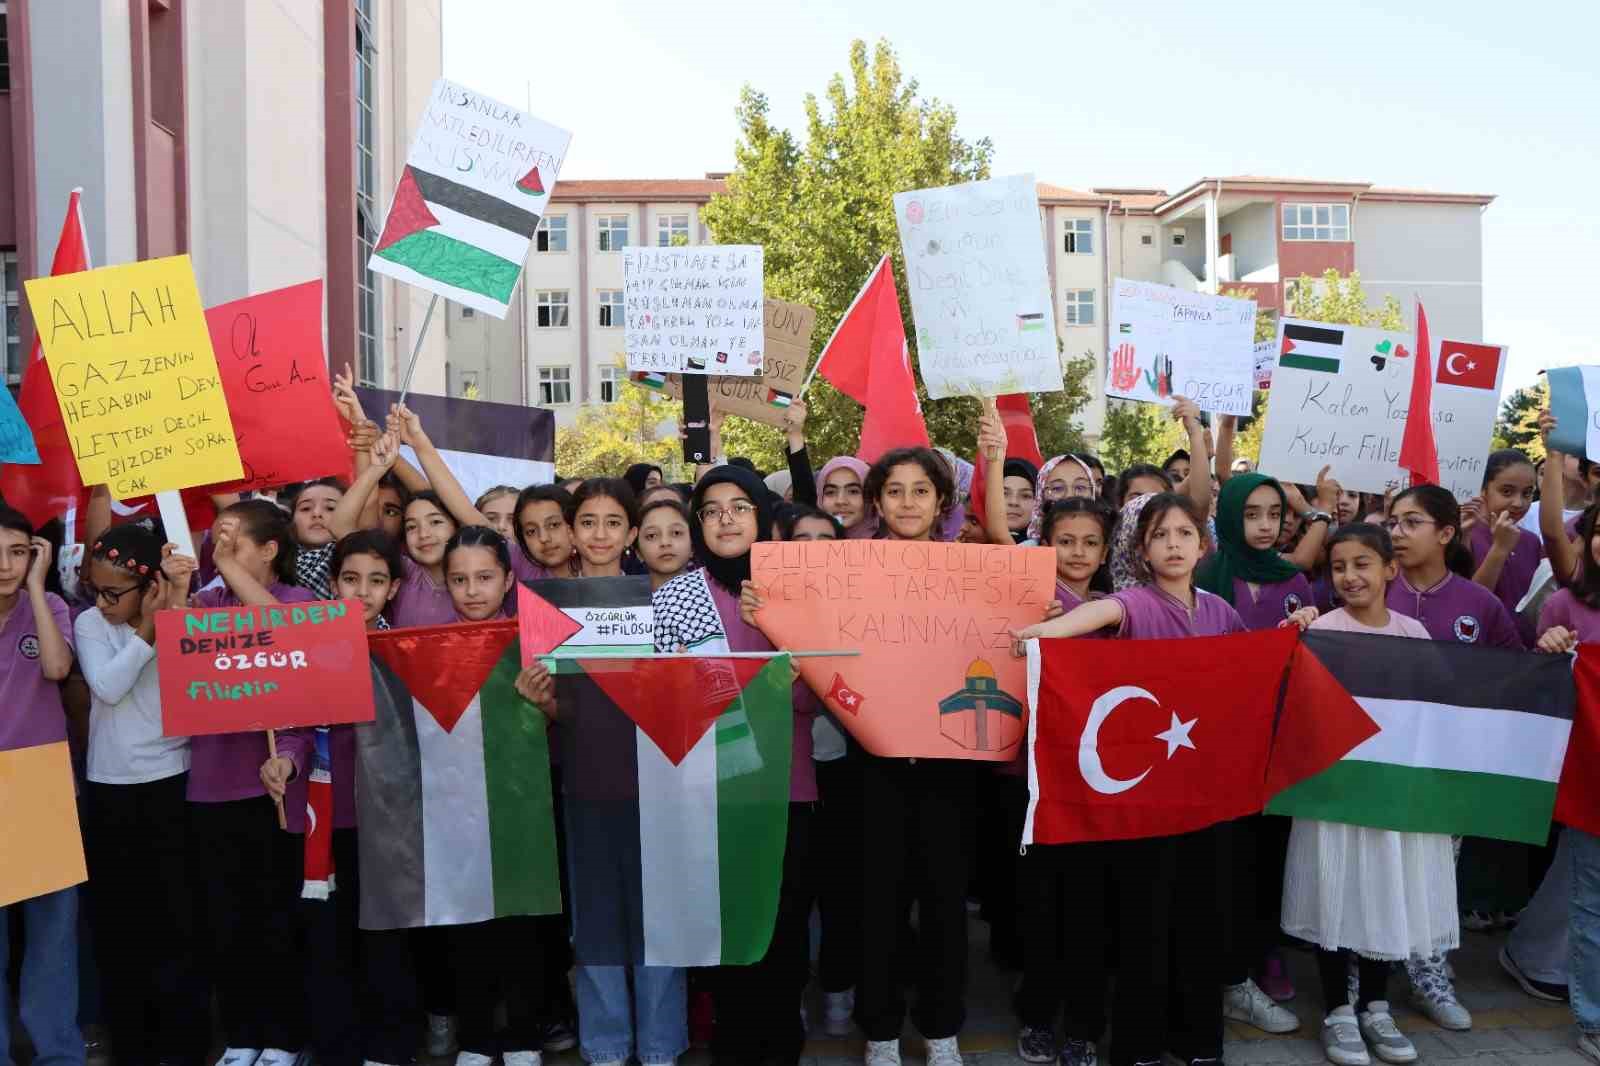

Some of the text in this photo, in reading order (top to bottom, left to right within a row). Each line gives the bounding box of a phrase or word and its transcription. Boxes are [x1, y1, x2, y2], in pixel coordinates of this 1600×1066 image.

[51, 285, 178, 345] ALLAH
[1299, 377, 1369, 418] Kalem
[73, 425, 153, 460] LETTEN
[1357, 433, 1401, 464] Fille
[116, 475, 149, 494] CAK
[759, 572, 1040, 606] YERDE TARAFSIZ
[837, 613, 1012, 650] KALINMAZ
[214, 651, 309, 671] ÖZGÜR
